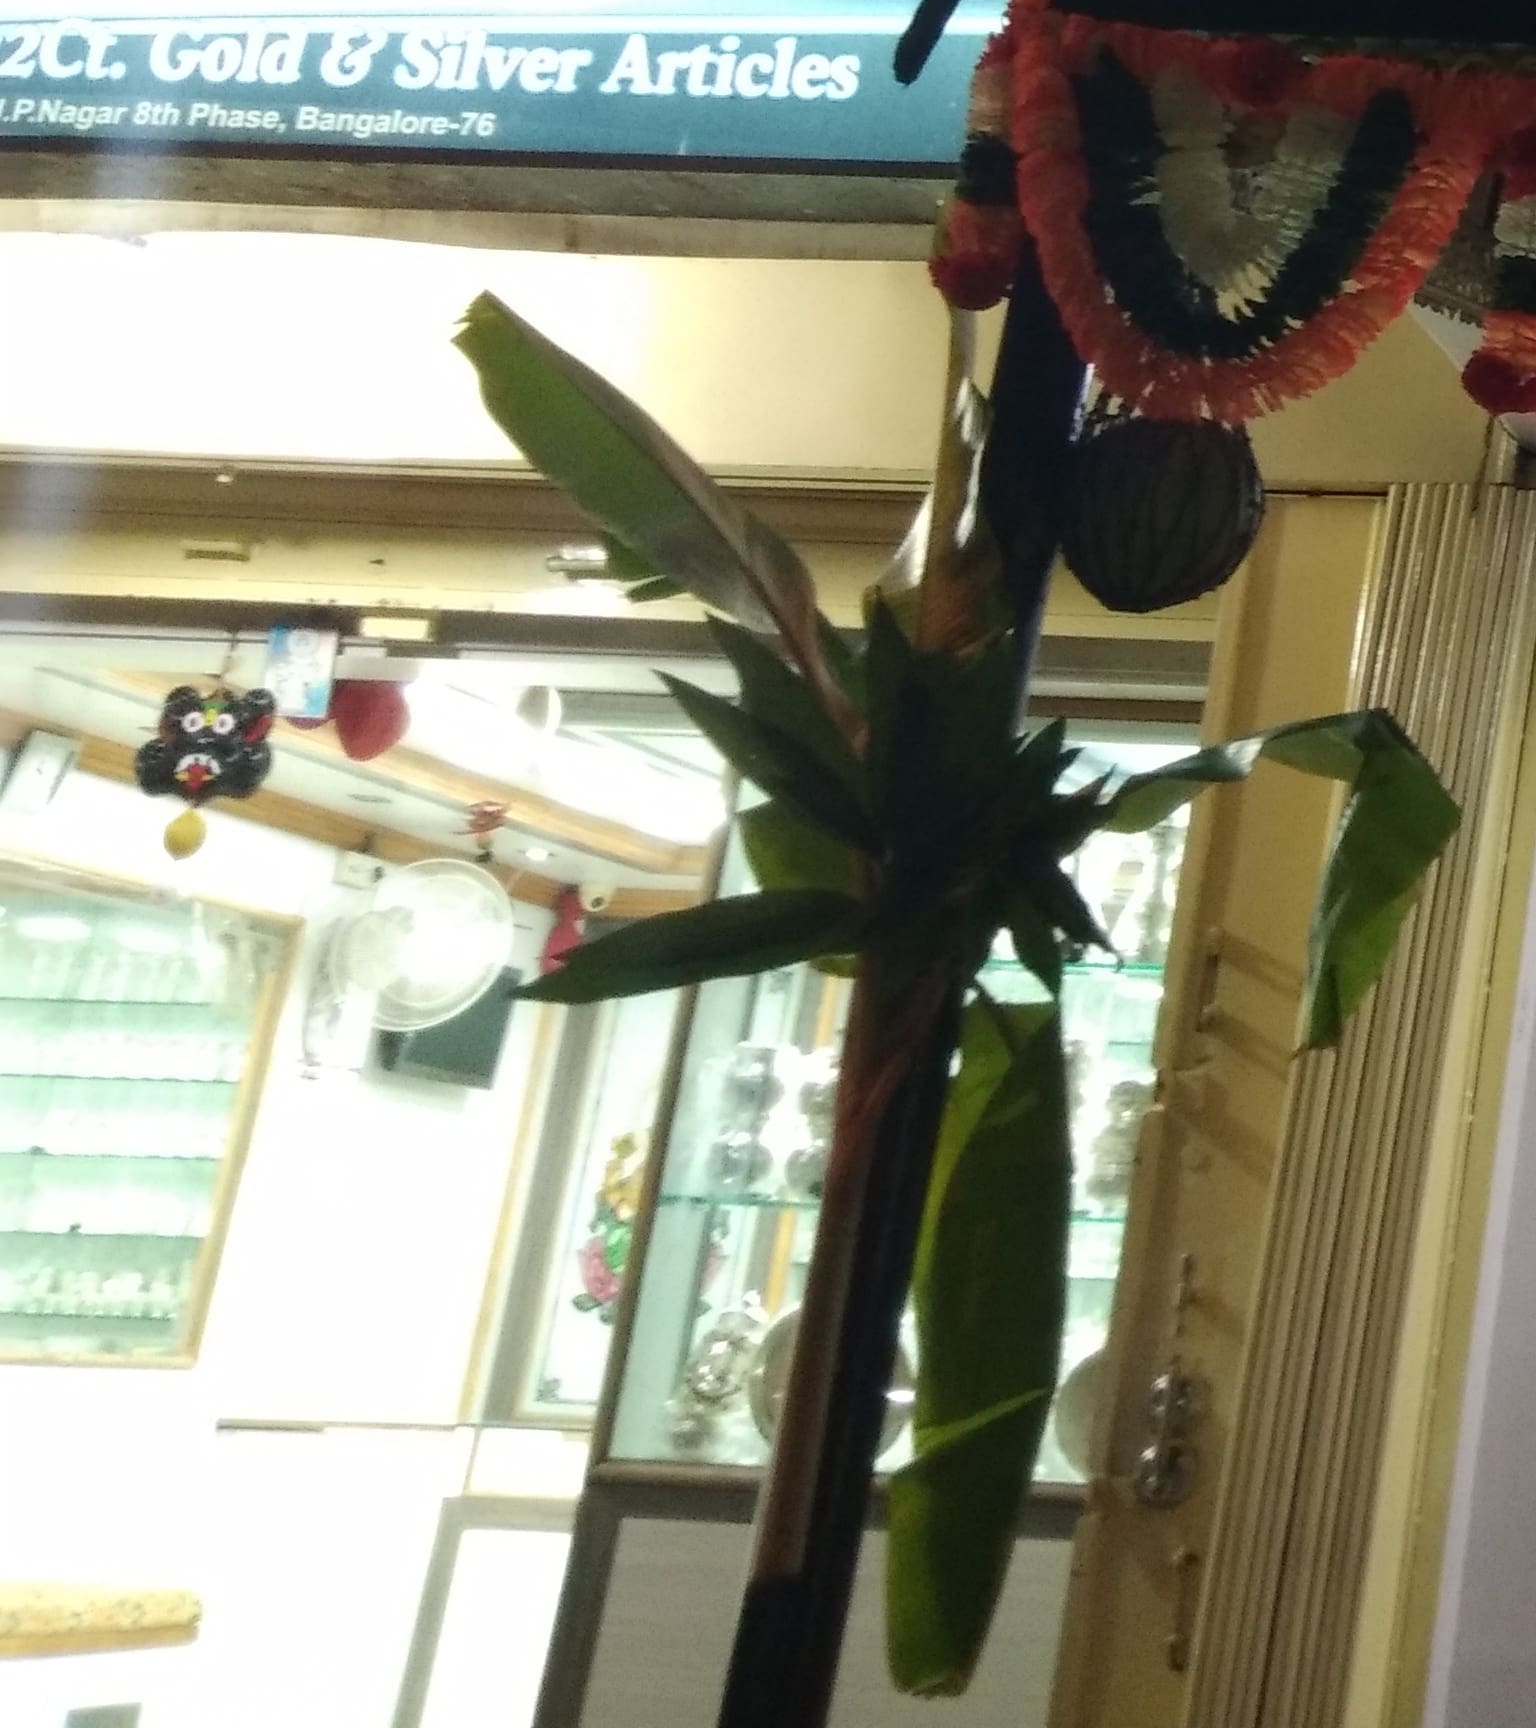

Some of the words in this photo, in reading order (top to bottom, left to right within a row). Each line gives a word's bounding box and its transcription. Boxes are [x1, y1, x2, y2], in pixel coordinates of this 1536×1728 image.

[0, 17, 127, 79] 2Ct.
[150, 27, 307, 85] Gold
[320, 26, 388, 87] &
[393, 28, 594, 92] Silver
[599, 33, 861, 100] Articles
[133, 101, 181, 126] 8th
[188, 102, 288, 133] Phase,
[294, 105, 497, 139] Bangalore-76
